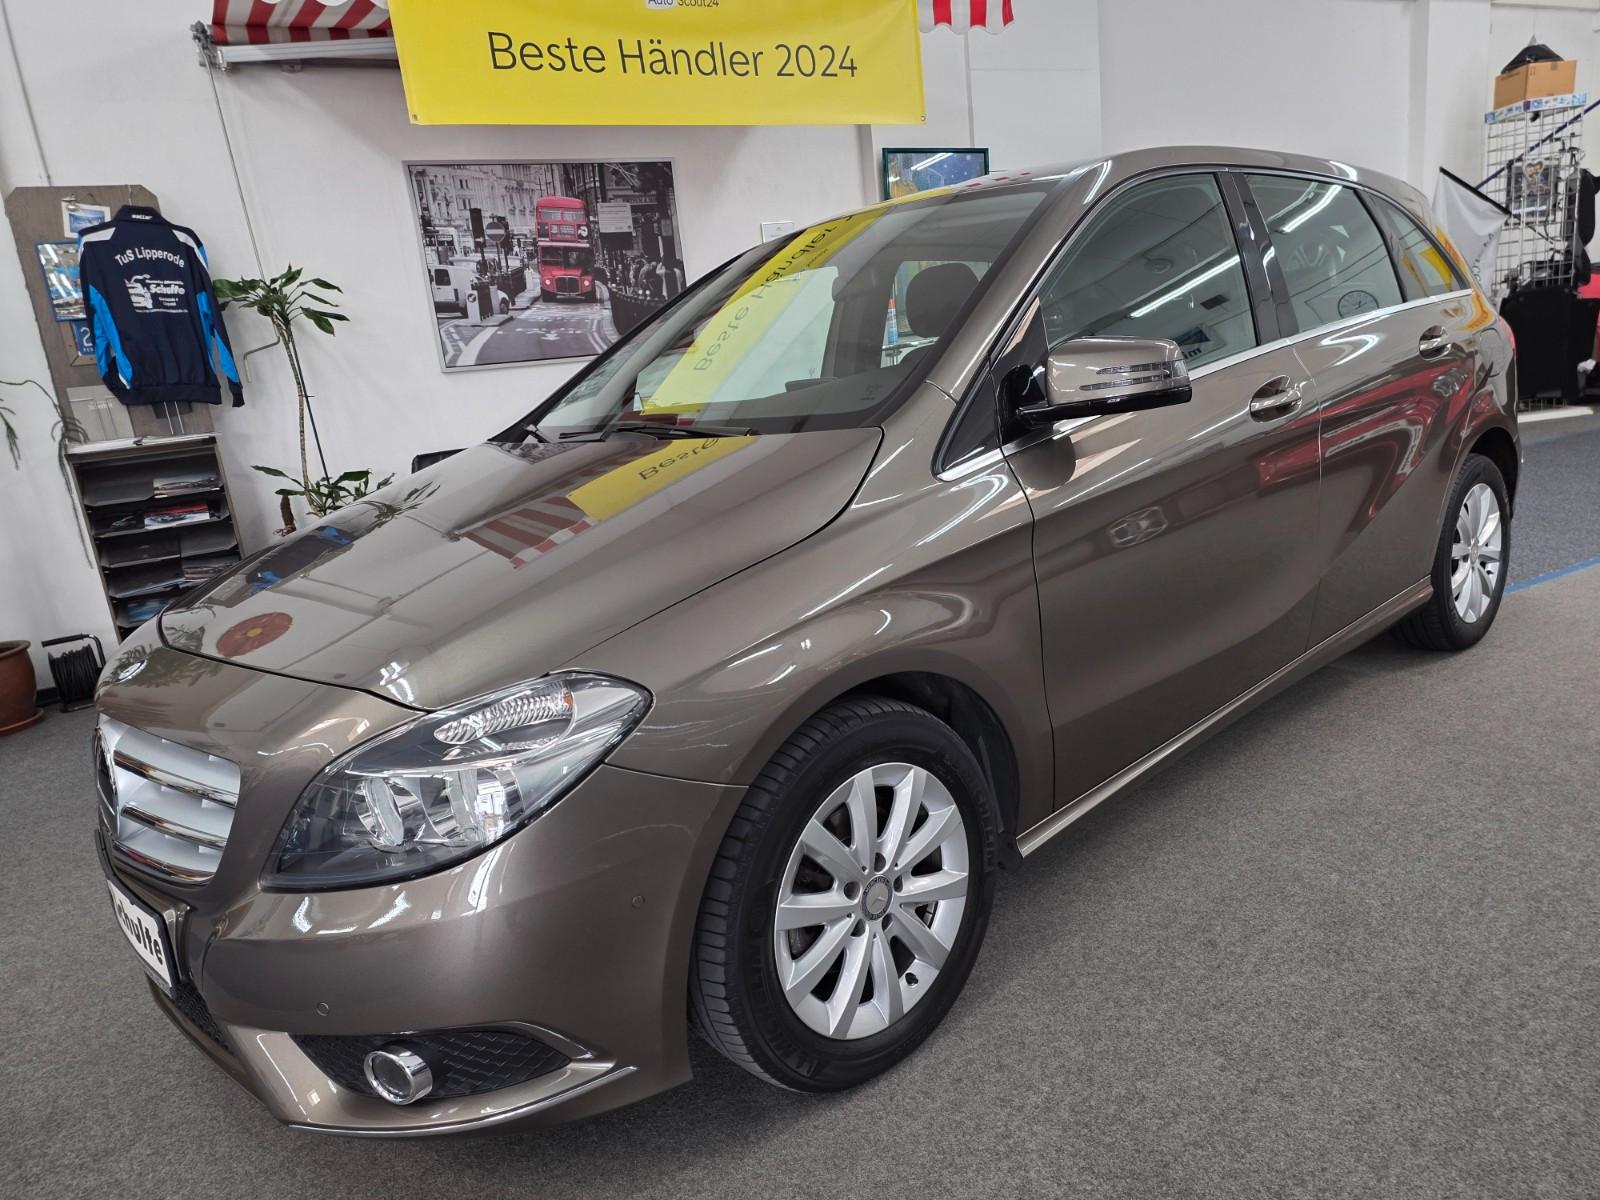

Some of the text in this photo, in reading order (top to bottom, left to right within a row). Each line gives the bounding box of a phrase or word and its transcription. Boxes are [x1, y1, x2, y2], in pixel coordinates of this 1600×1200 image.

[487, 31, 858, 78] Beste Händler 2024
[115, 246, 185, 268] TuS Lipperode
[114, 893, 163, 965] chulte
